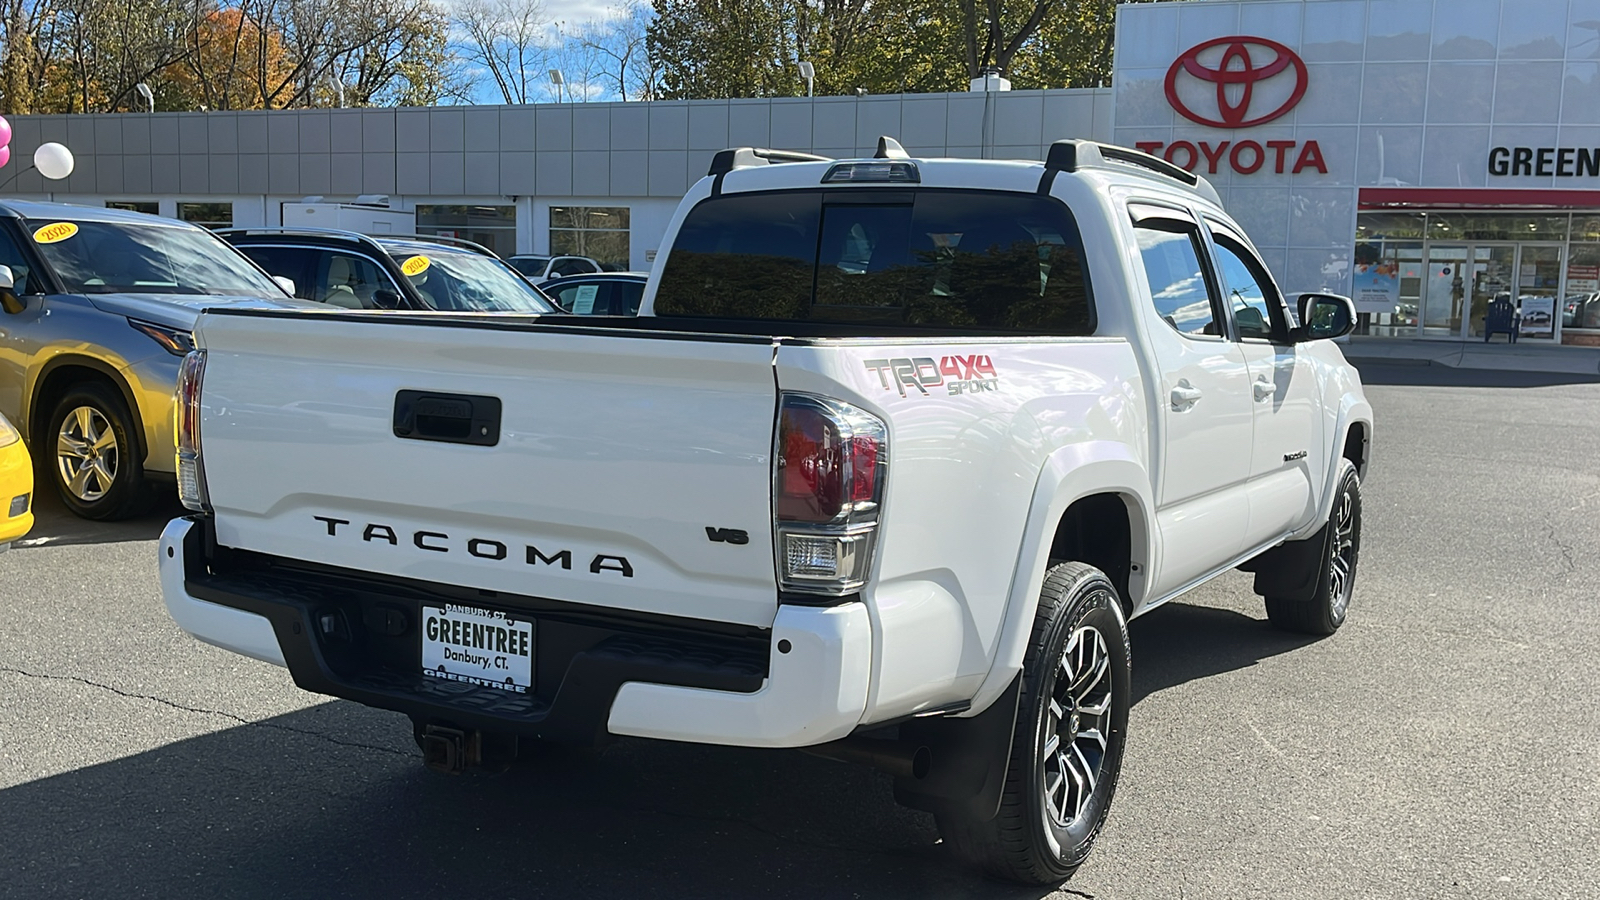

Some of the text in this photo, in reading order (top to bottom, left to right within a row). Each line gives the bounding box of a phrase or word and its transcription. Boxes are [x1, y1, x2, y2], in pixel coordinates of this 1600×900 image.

[1136, 140, 1328, 174] TOYOTA
[1488, 147, 1600, 176] GREEN
[41, 224, 71, 241] 2020
[406, 257, 426, 273] 2021
[863, 357, 944, 398] TRD
[947, 379, 999, 396] SPORT
[313, 516, 634, 577] TACOMA
[705, 526, 749, 545] V6
[426, 616, 528, 657] GREENTREE
[444, 647, 509, 670] Danbury, CT.
[423, 669, 526, 693] GREENTREE
